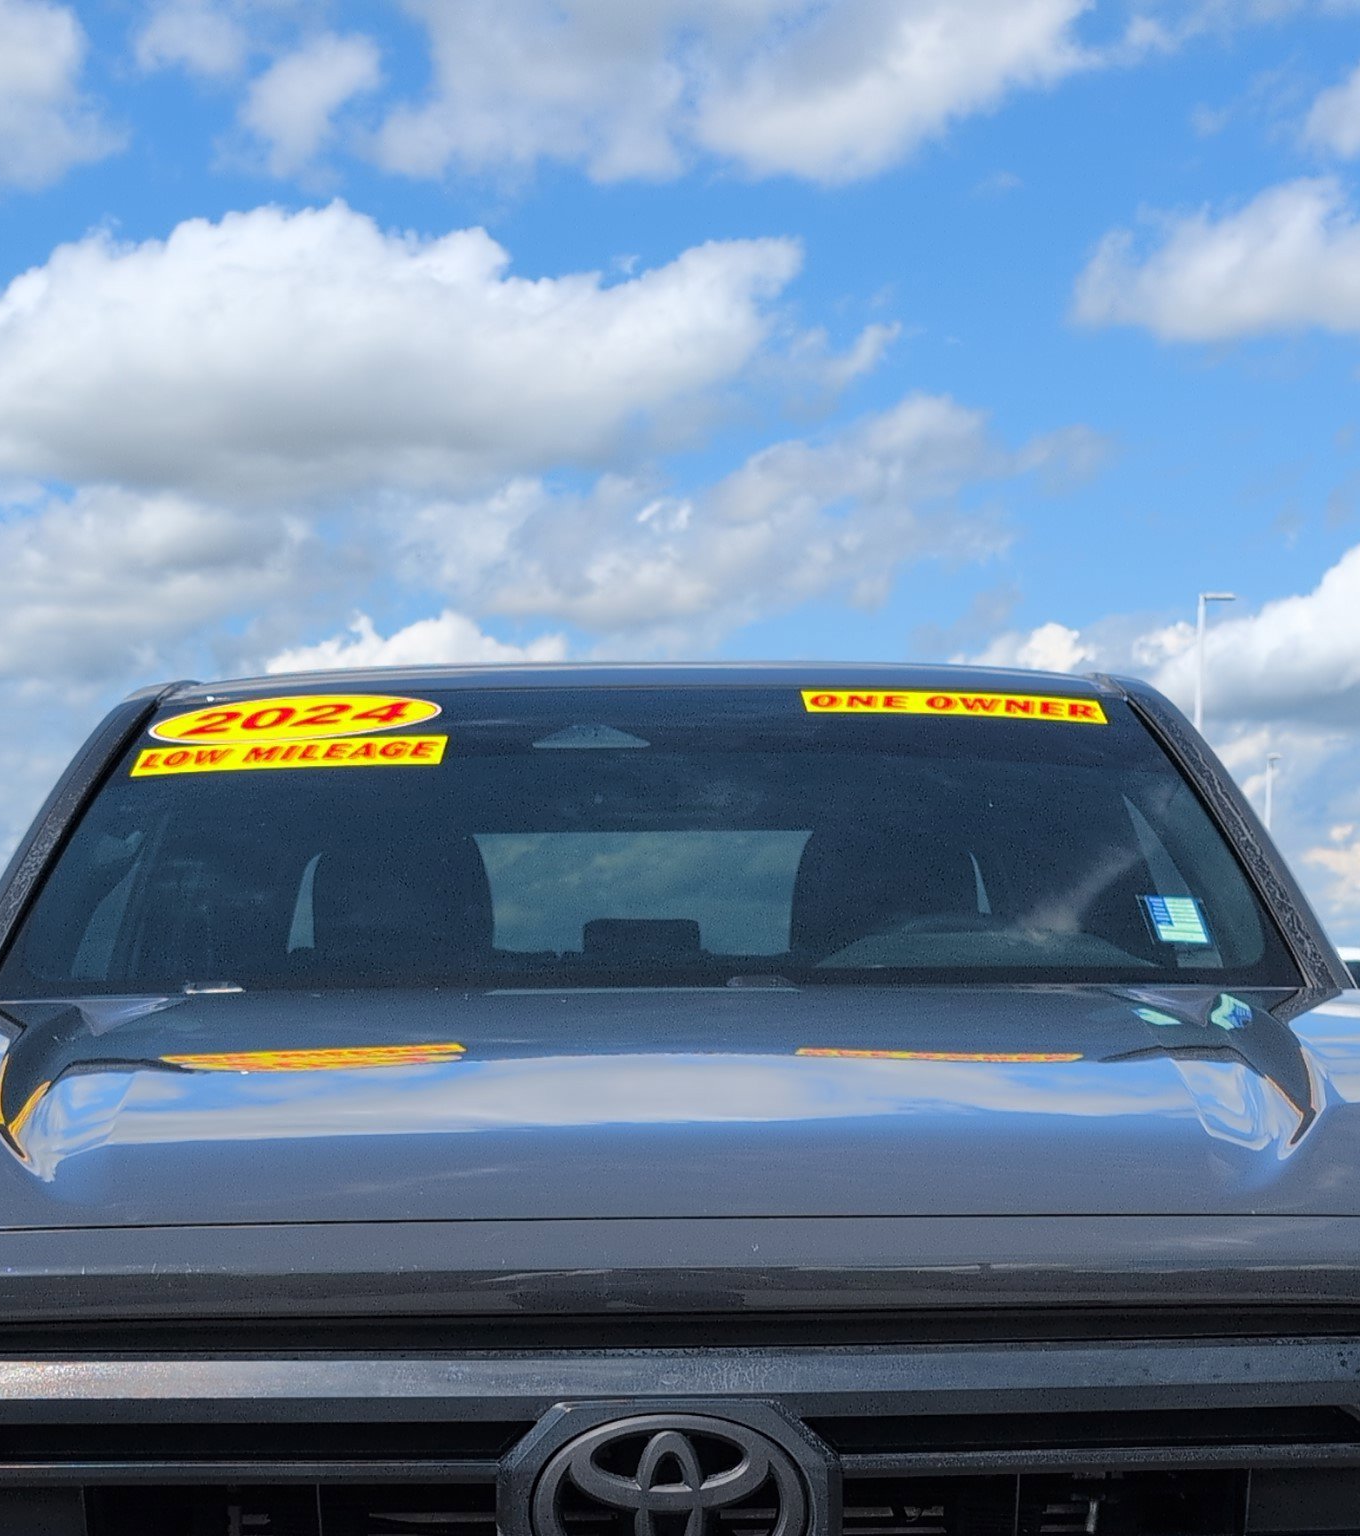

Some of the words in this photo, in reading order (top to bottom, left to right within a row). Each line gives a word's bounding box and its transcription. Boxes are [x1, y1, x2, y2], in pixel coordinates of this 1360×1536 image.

[178, 701, 414, 737] 2024
[810, 694, 909, 709] ONE
[926, 696, 1098, 720] OWNER
[140, 749, 236, 768] LOW
[242, 740, 439, 763] MILEAGE
